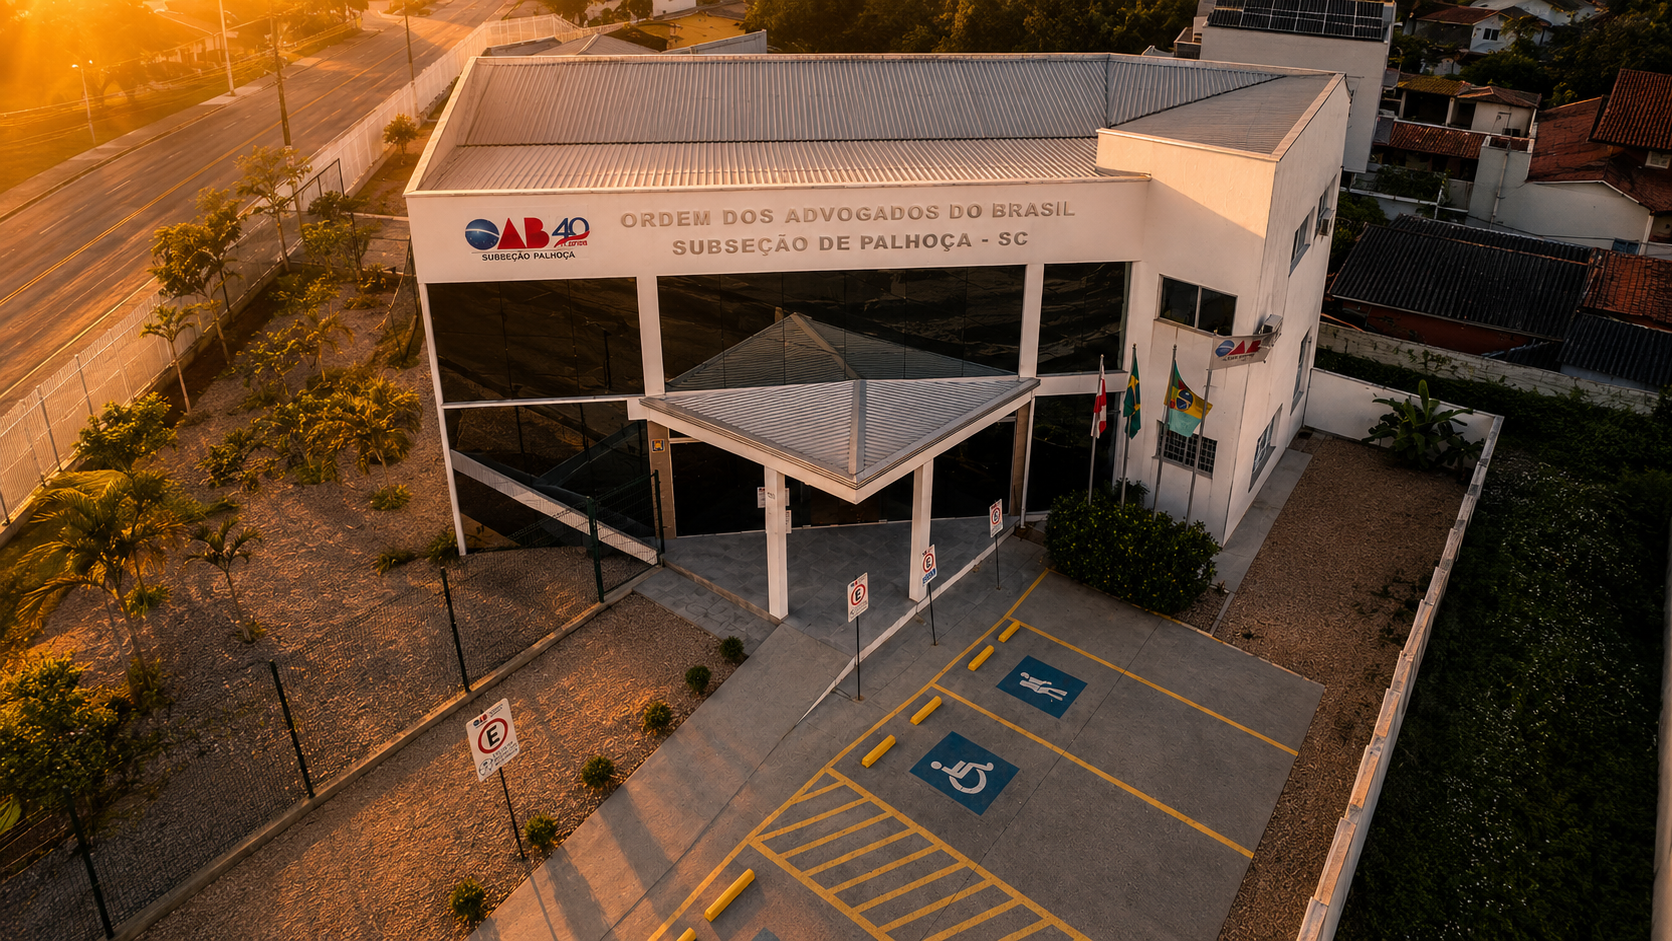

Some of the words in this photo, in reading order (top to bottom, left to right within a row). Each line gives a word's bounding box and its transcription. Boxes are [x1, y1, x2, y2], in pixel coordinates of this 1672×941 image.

[620, 210, 712, 228] ORDEM
[722, 208, 774, 225] DOS
[784, 204, 940, 224] ADVOGADOS
[949, 203, 983, 220] DO
[992, 200, 1076, 218] BRASIL
[464, 217, 550, 250] OAB
[672, 234, 809, 256] SUBSEÇÃO
[818, 235, 850, 251] DE
[860, 232, 972, 252] PALHOÇA
[998, 231, 1029, 247] SC
[533, 251, 576, 261] PALHOÇA
[855, 588, 861, 602] E
[486, 725, 500, 747] E
